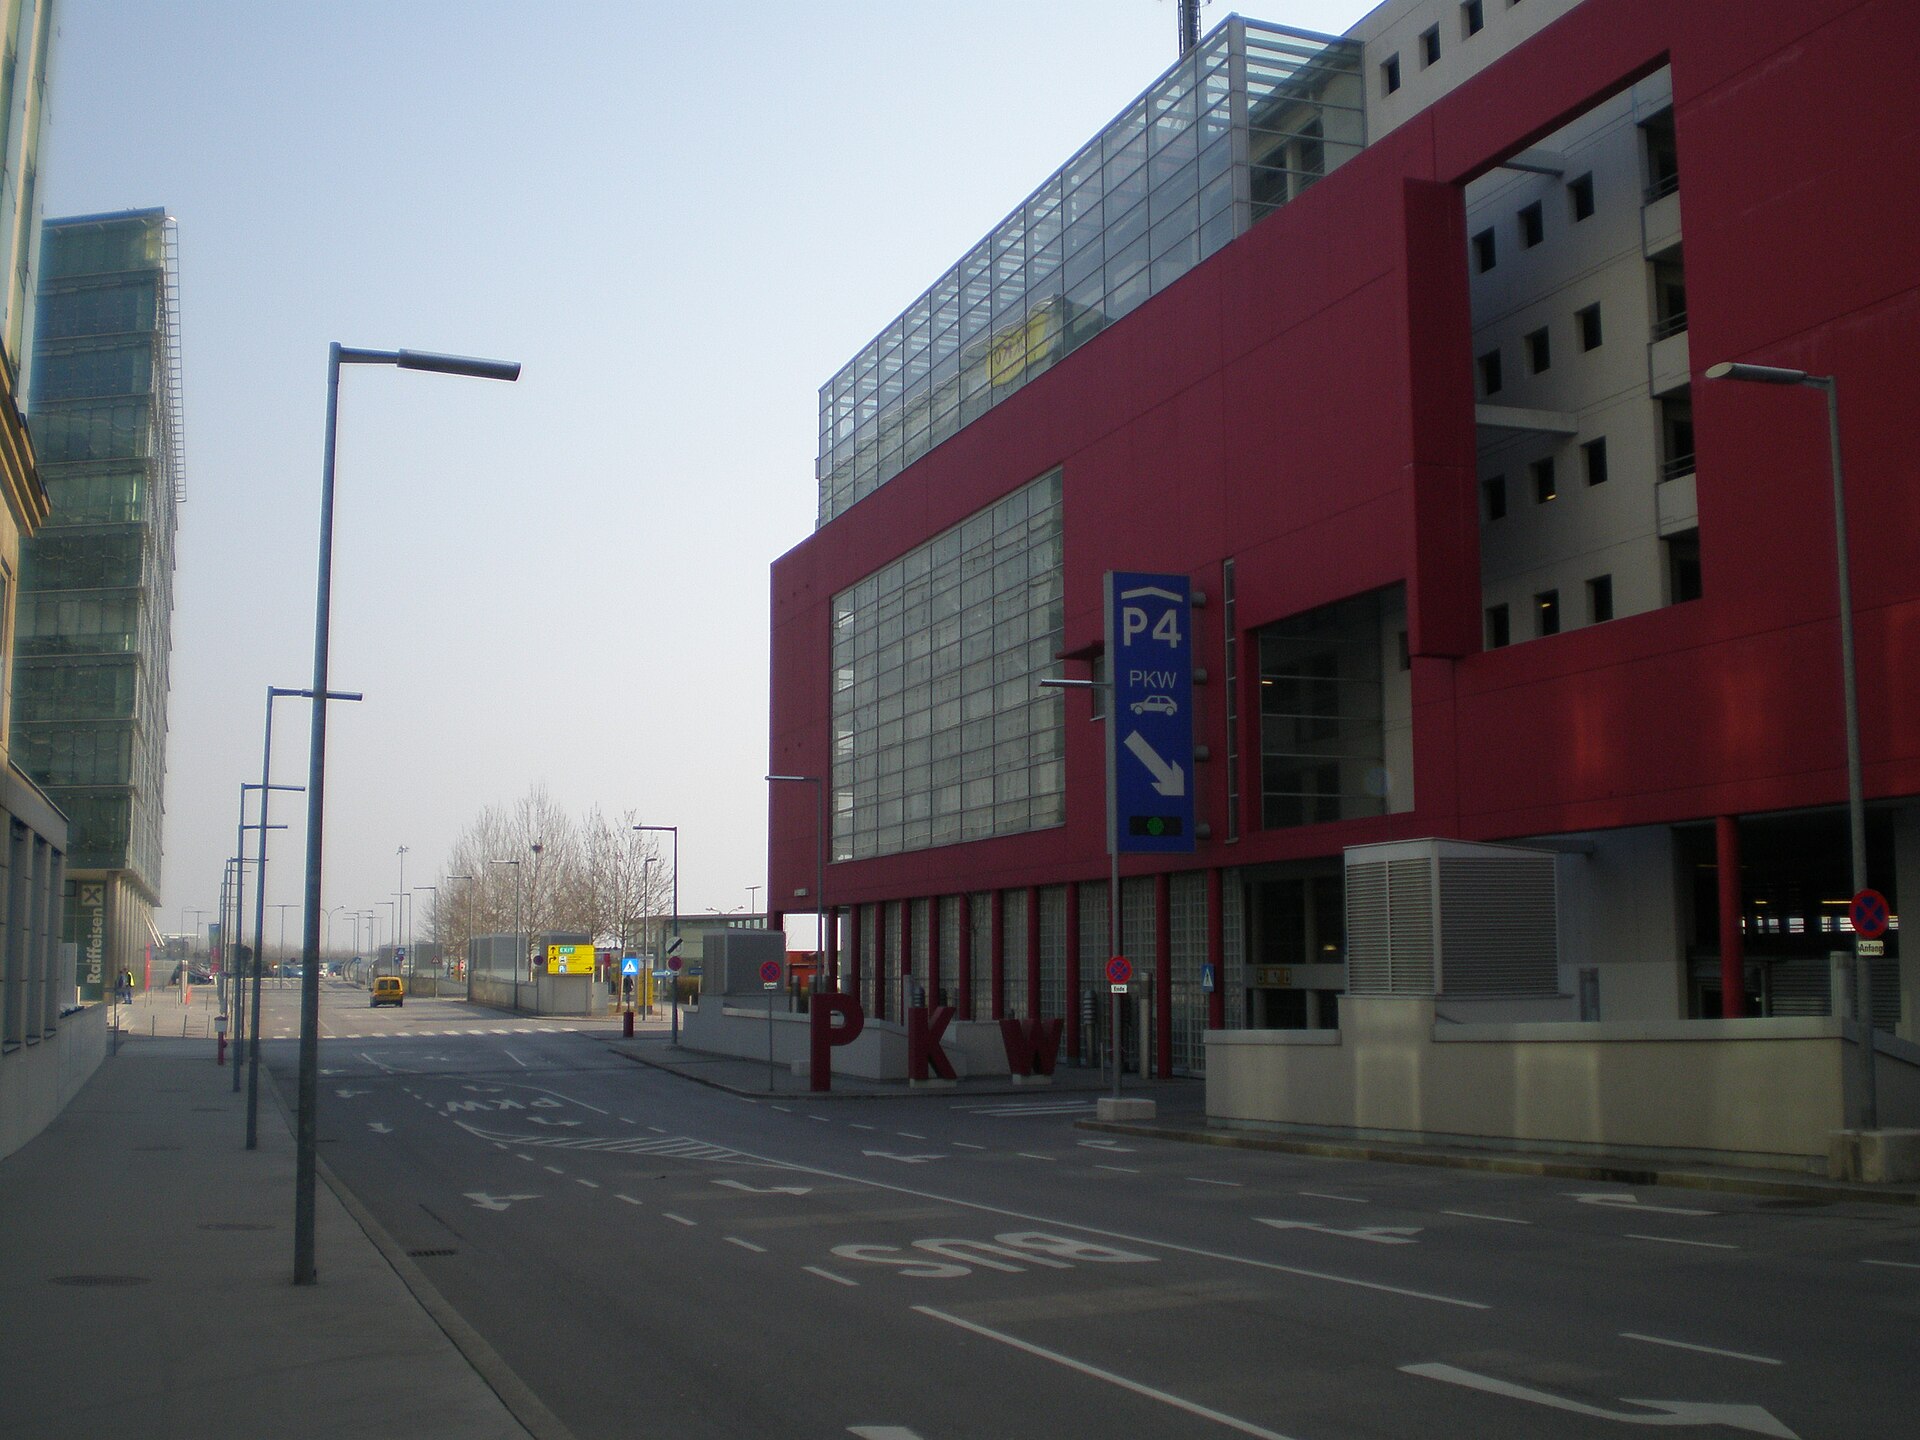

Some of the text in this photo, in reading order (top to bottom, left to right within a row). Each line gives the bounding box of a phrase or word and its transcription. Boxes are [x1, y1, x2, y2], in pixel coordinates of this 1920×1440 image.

[1122, 606, 1183, 649] P4
[1129, 669, 1177, 689] PKW
[86, 907, 103, 984] Raiffeisen
[1859, 943, 1884, 954] Anfang
[829, 1230, 1162, 1278] BUS
